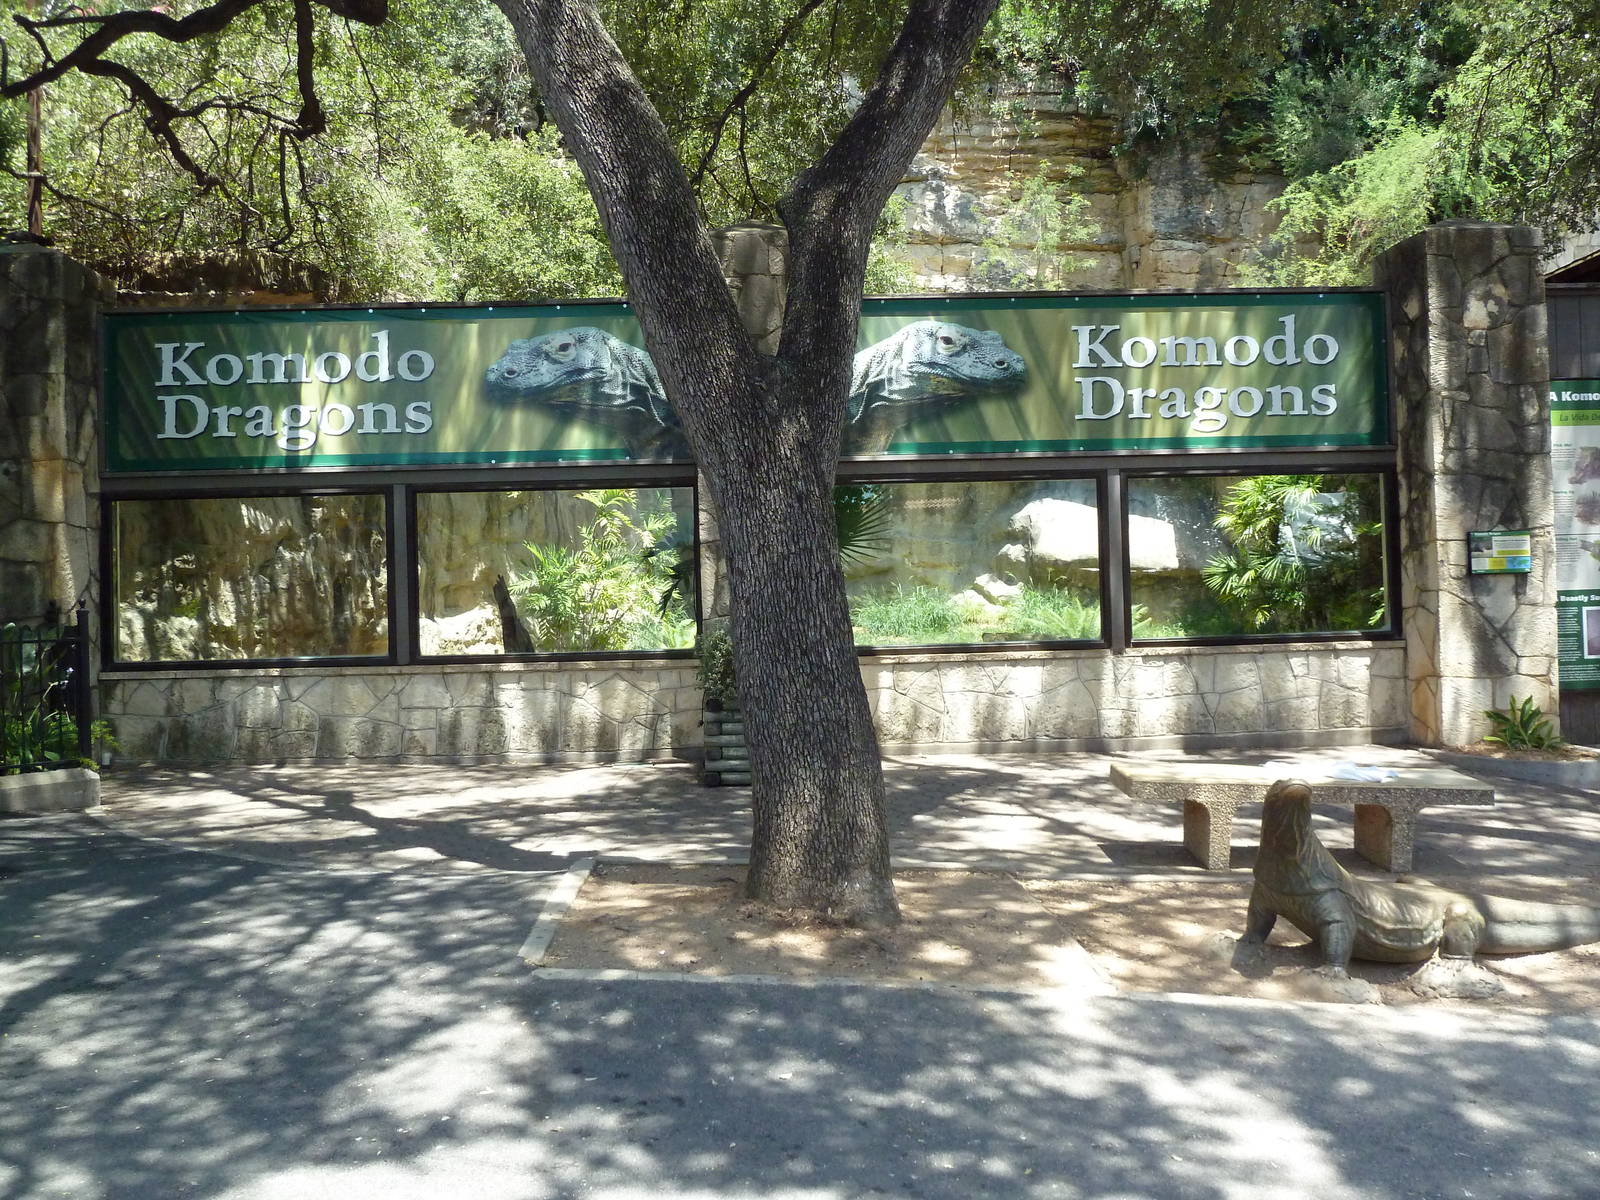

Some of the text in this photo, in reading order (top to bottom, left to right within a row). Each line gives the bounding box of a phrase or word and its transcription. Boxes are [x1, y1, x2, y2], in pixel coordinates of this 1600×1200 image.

[154, 329, 435, 386] Komodo
[1071, 314, 1339, 368] Komodo
[157, 394, 434, 451] Dragons
[1074, 376, 1338, 433] Dragons
